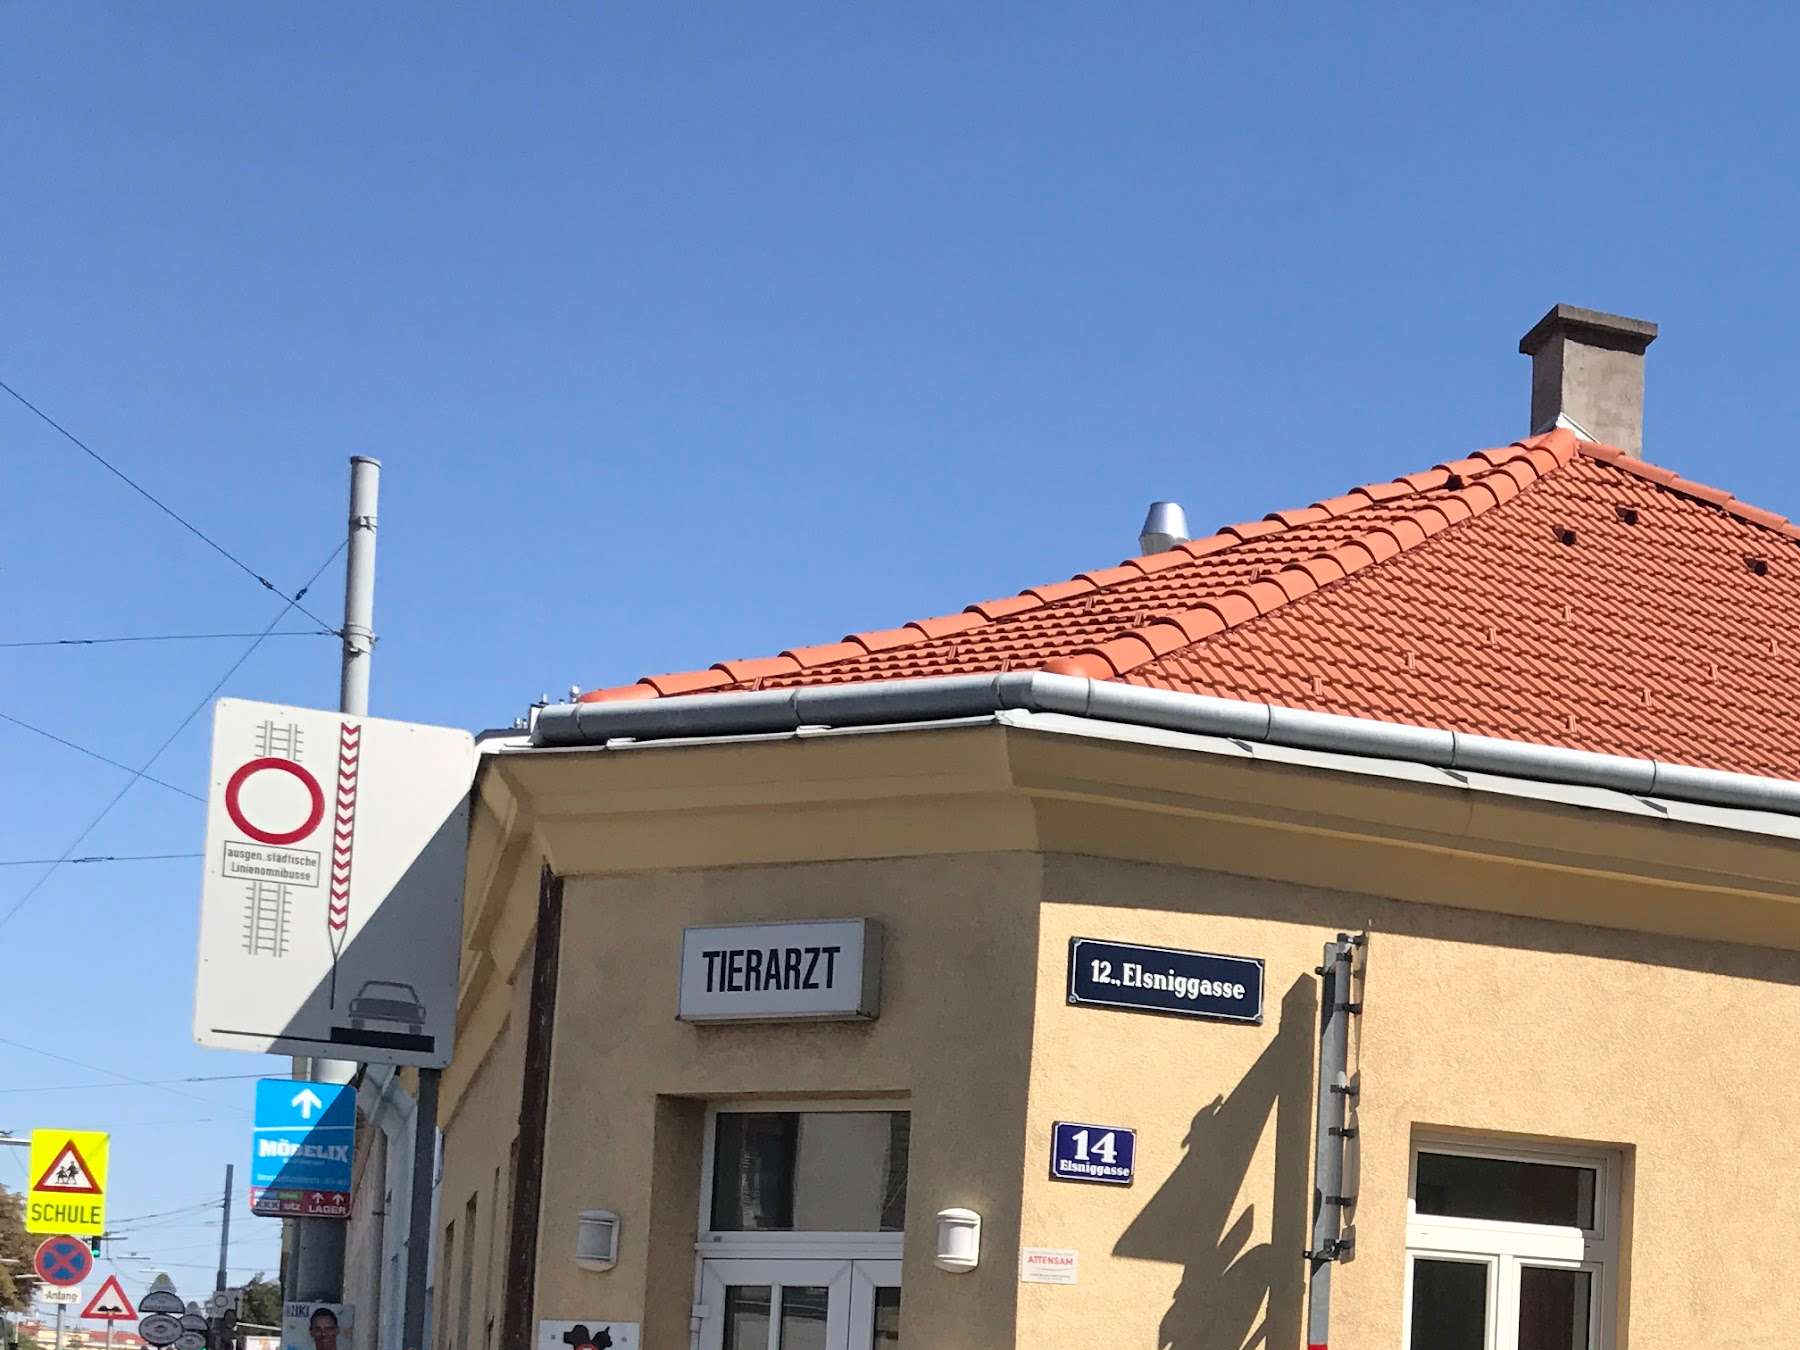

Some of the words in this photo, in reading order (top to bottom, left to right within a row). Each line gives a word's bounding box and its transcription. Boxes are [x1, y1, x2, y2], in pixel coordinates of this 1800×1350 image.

[702, 946, 841, 993] TIERARZT
[1122, 962, 1246, 1000] Elsniggasse
[1072, 1129, 1118, 1164] 14
[1059, 1159, 1131, 1178] Elsniggasse
[31, 1203, 101, 1225] SCHULE
[308, 1205, 347, 1215] LAGER
[1028, 1255, 1073, 1265] ATTENSAM
